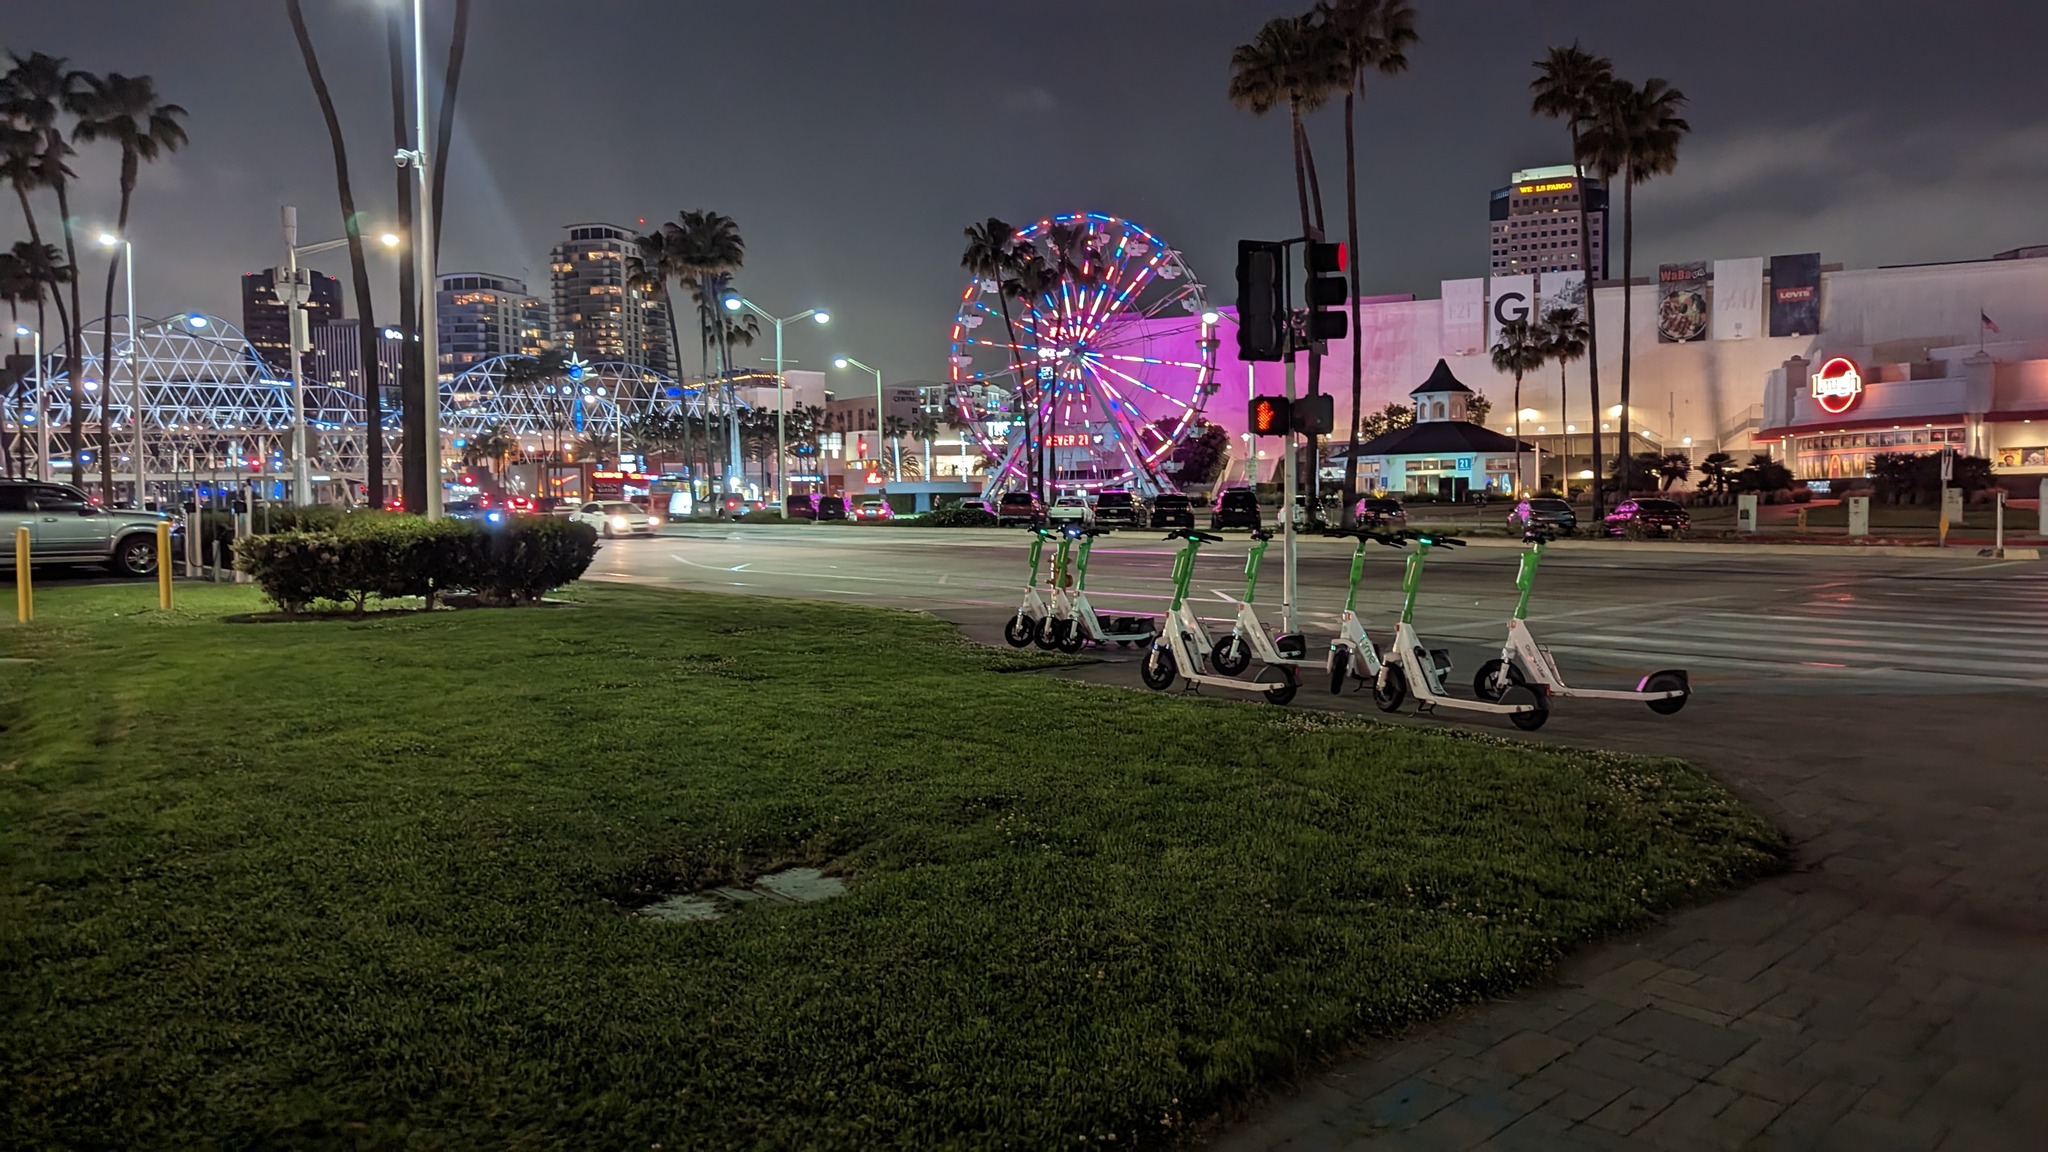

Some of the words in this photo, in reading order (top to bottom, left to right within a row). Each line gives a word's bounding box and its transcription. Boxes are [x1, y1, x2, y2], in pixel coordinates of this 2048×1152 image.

[1546, 183, 1573, 191] FARGO
[1494, 292, 1530, 325] G
[1078, 434, 1089, 446] 21
[1459, 459, 1469, 468] 21
